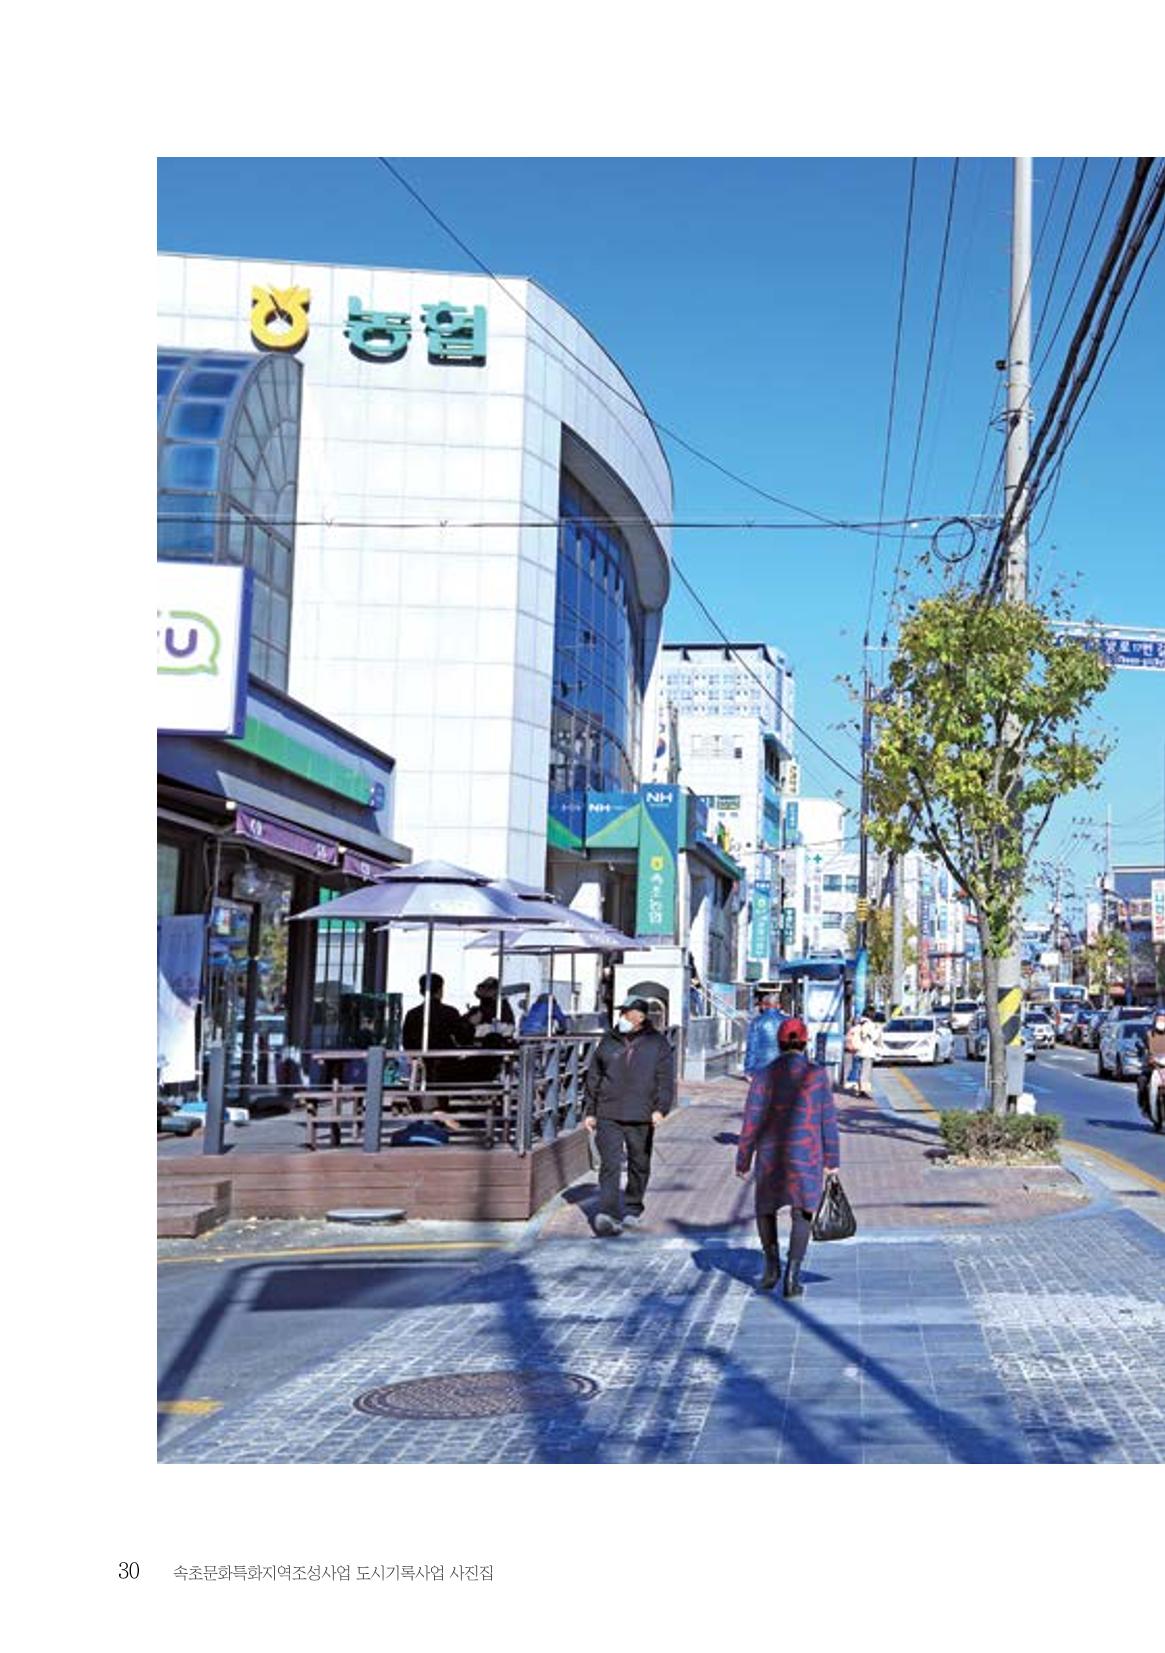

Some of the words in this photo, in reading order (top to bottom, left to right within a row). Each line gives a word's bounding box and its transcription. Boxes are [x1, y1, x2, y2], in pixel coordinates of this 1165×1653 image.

[345, 296, 488, 356] 농협
[157, 626, 198, 658] U
[588, 803, 611, 813] NH
[646, 792, 673, 803] NH
